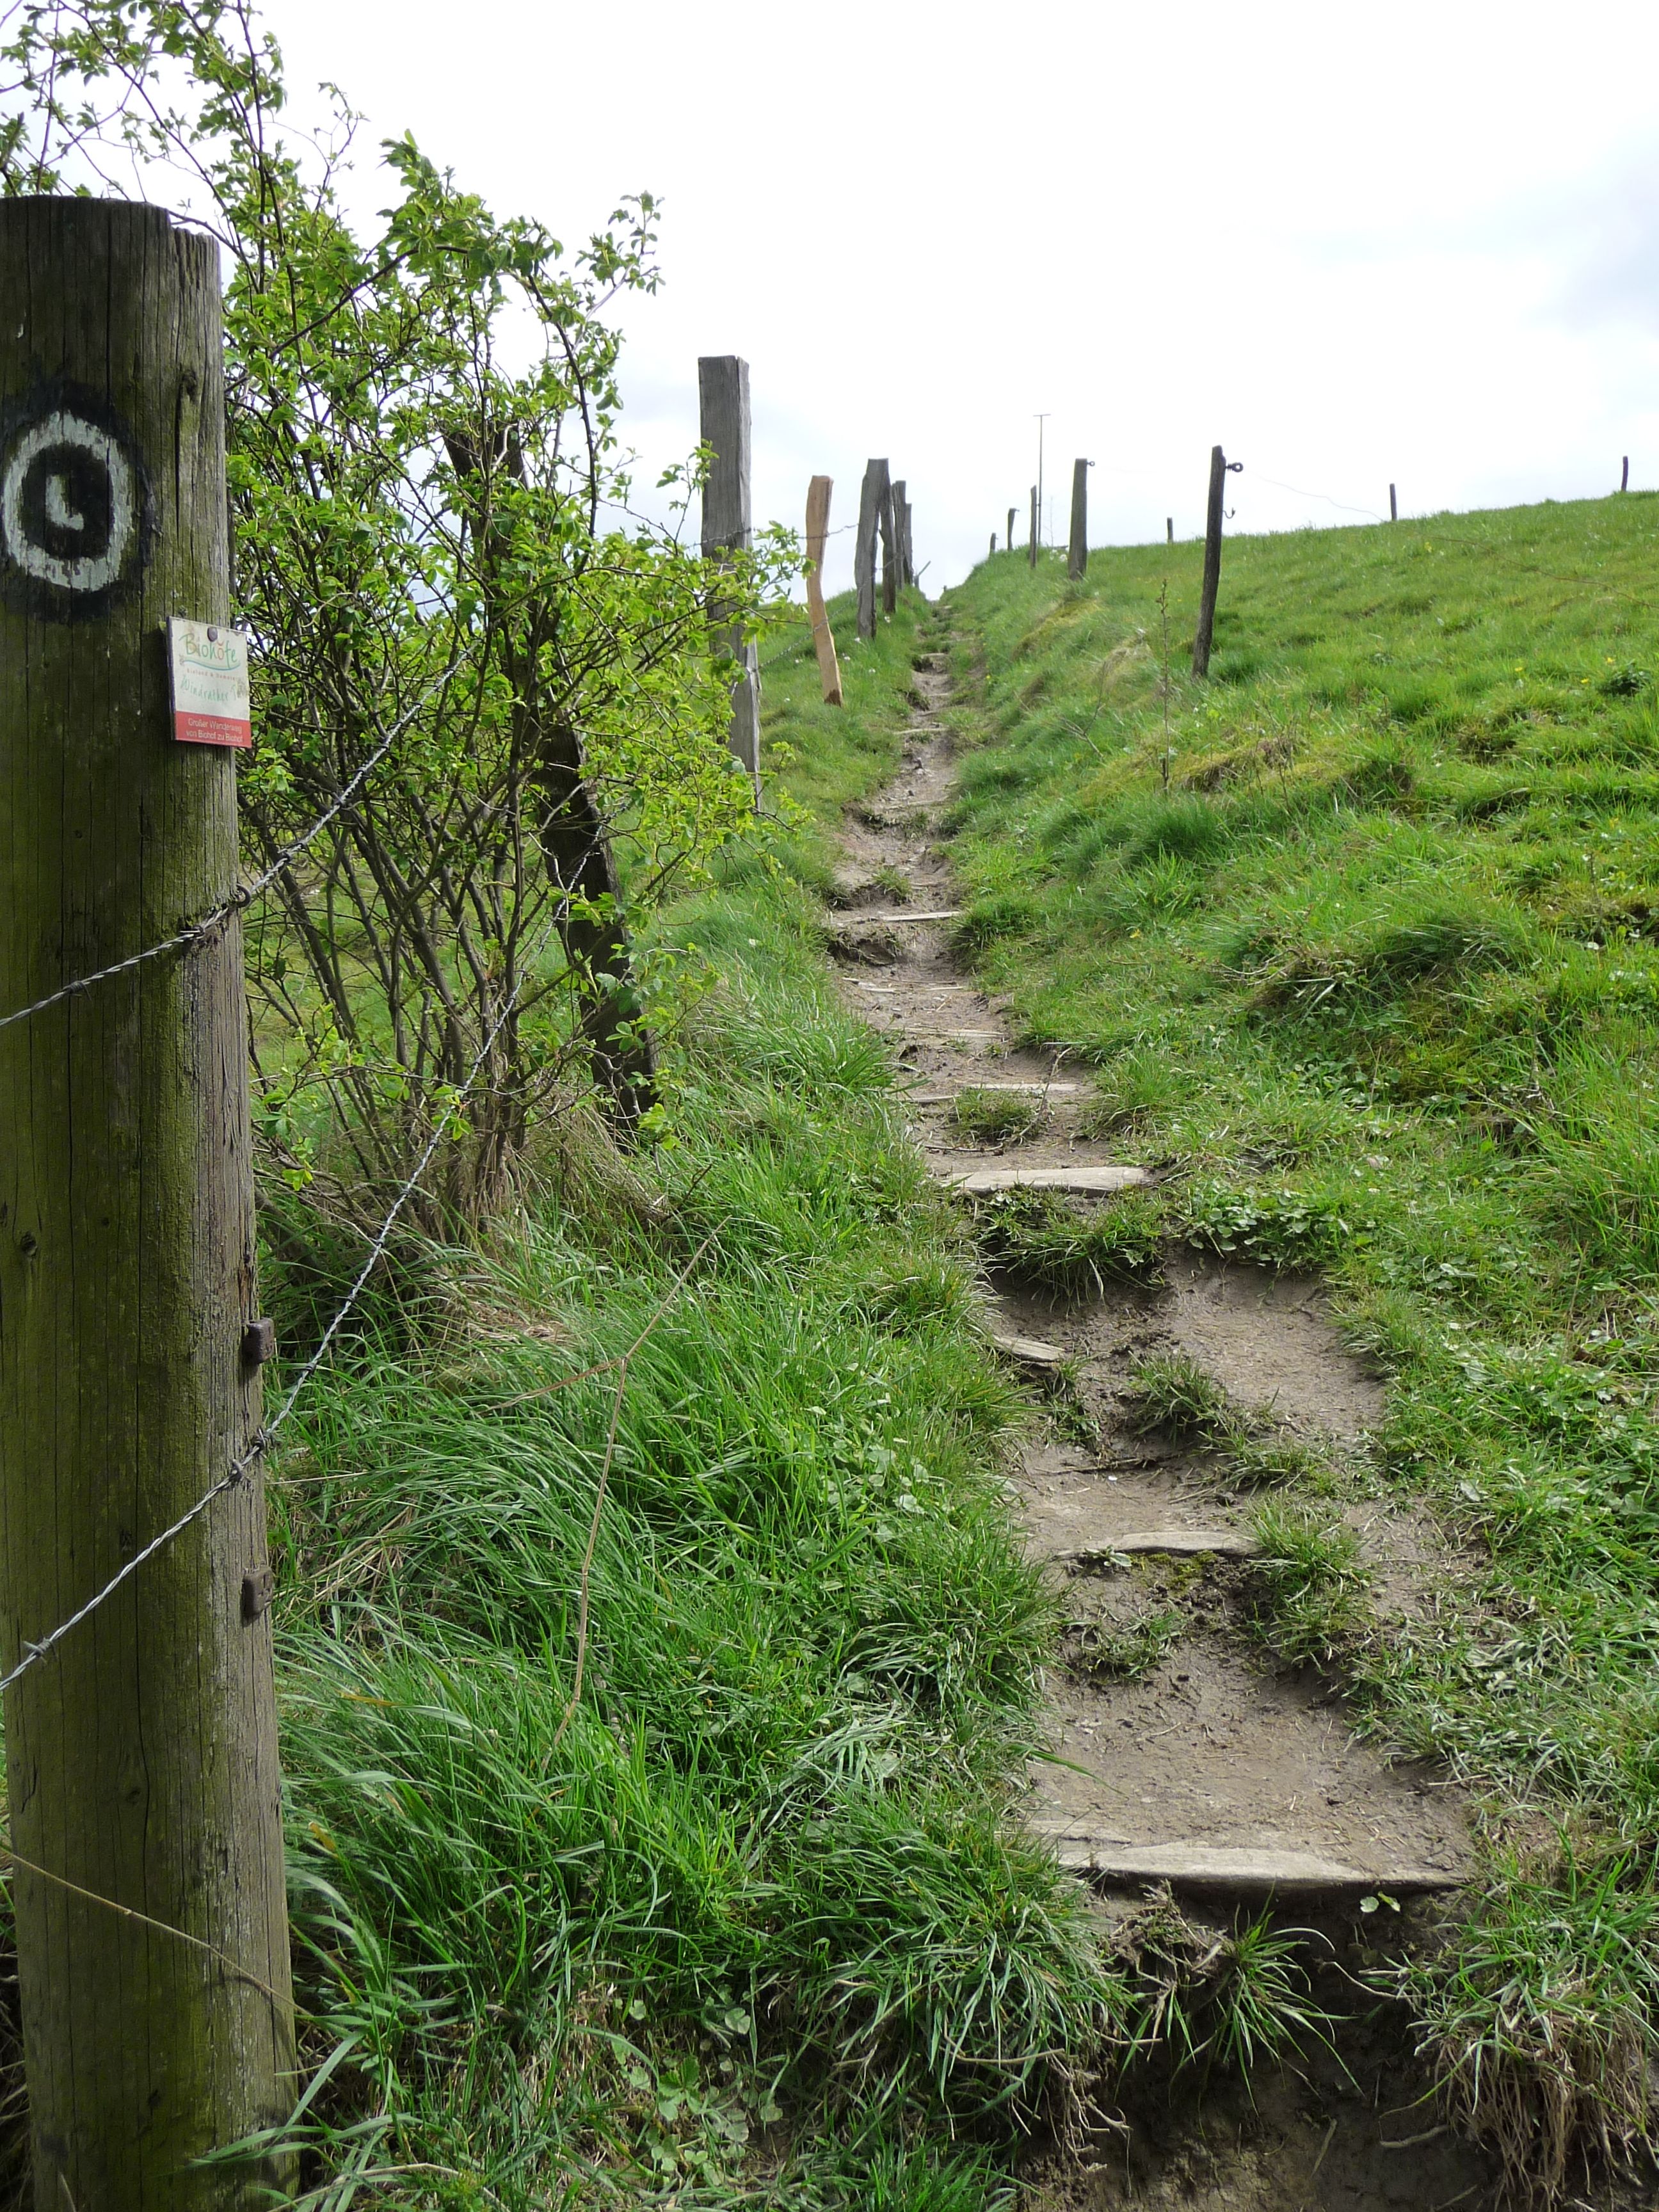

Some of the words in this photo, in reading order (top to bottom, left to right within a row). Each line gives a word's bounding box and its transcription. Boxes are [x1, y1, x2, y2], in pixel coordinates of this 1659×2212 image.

[188, 717, 209, 728] Großer
[210, 720, 242, 735] Wanderweg
[198, 729, 216, 740] Biohof
[225, 732, 243, 742] Biohof
